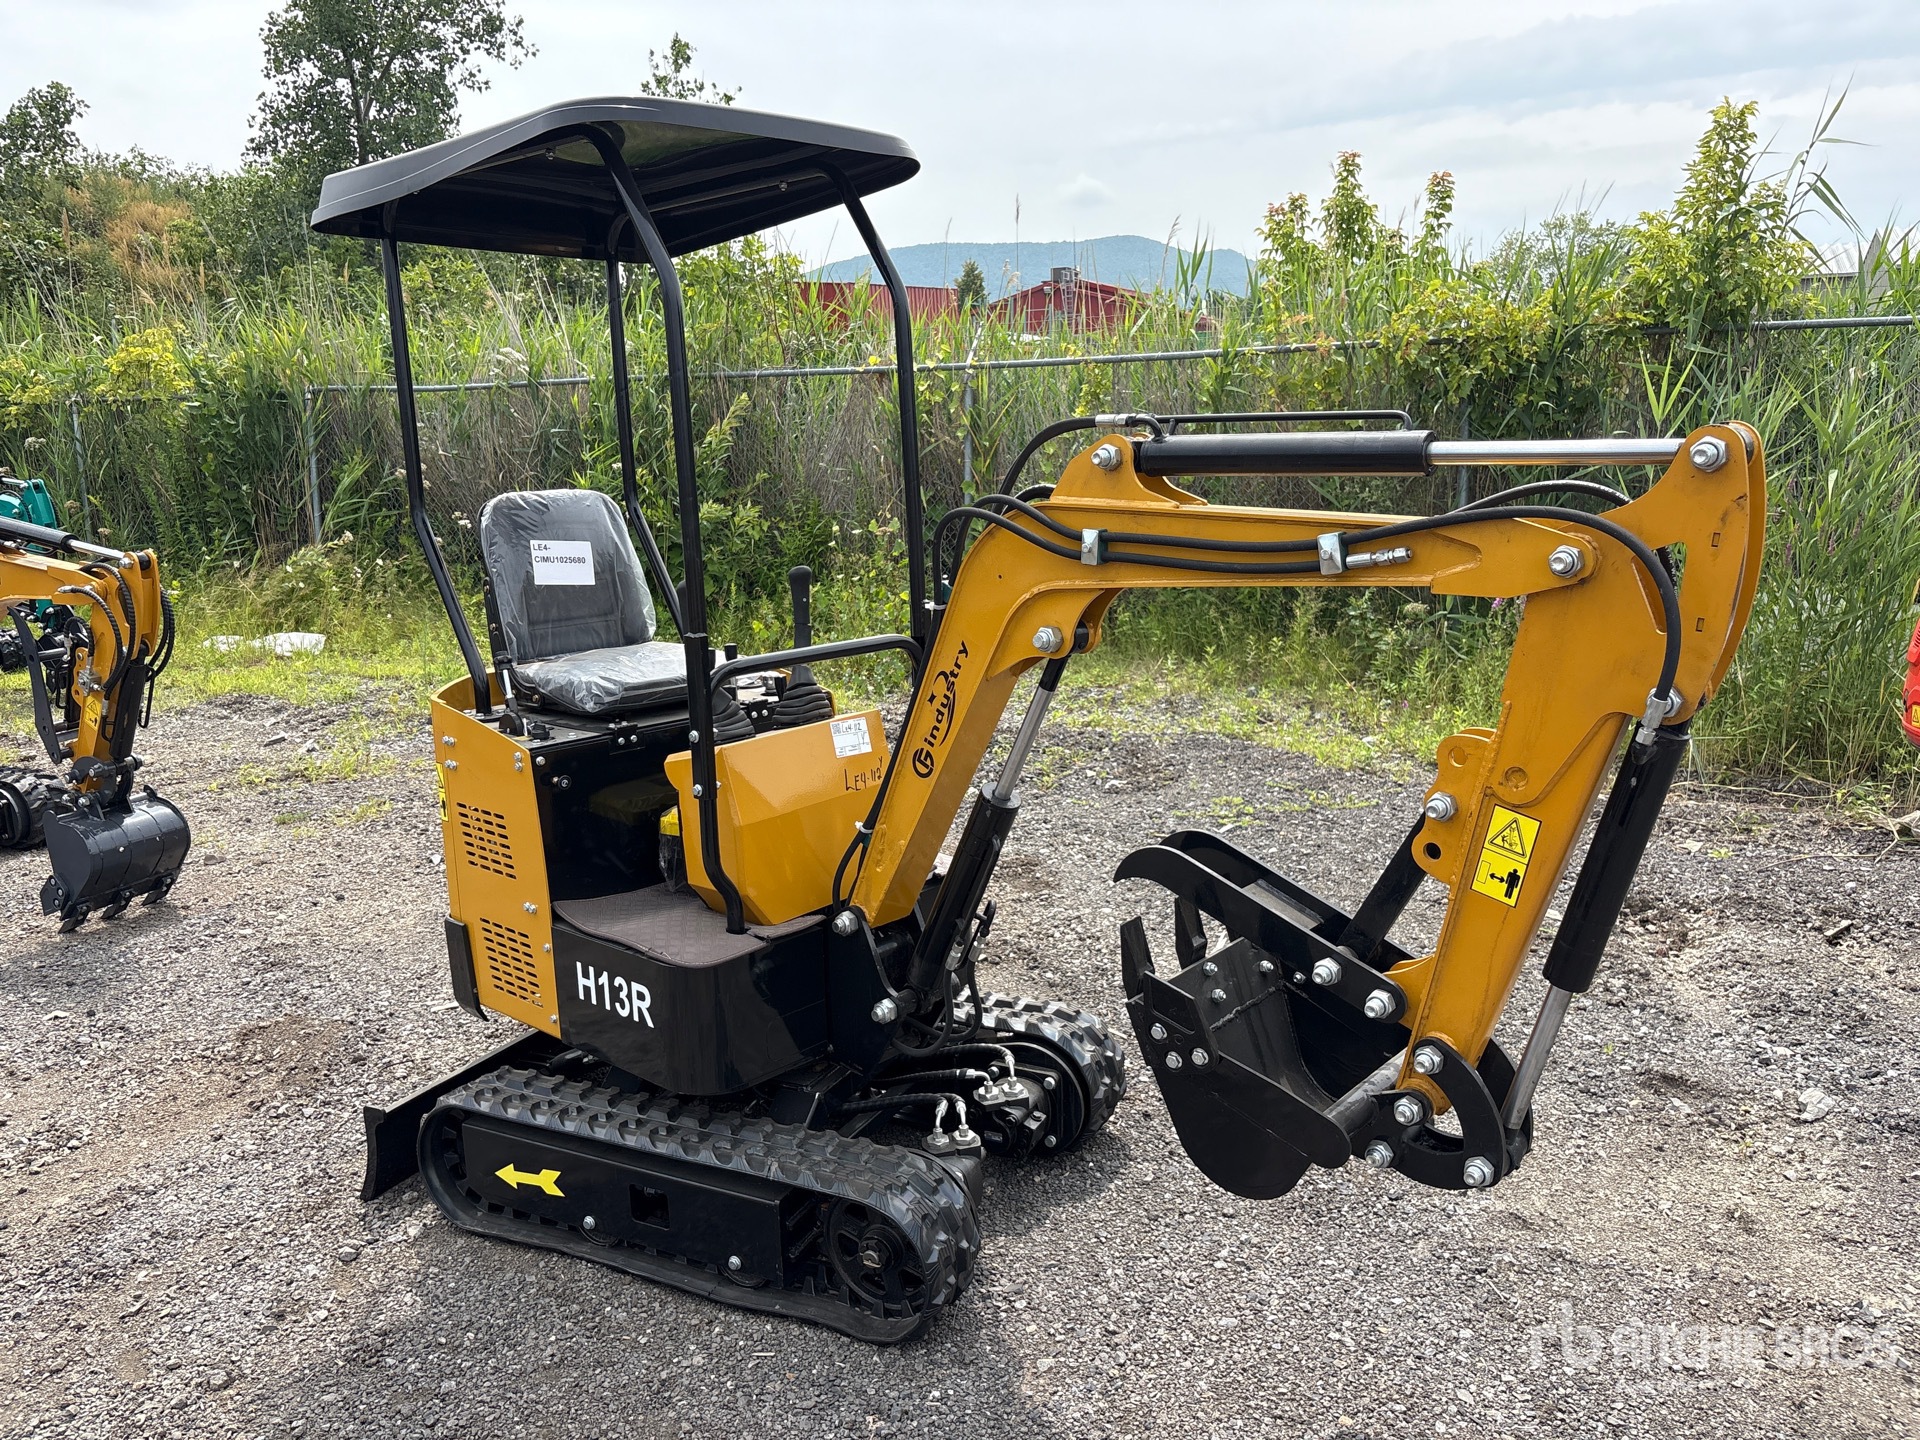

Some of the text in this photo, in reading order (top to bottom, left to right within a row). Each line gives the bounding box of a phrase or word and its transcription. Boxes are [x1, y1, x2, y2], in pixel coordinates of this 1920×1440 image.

[532, 543, 551, 551] LE4-
[534, 555, 586, 564] CIMU1025680
[576, 961, 655, 1029] H13R
